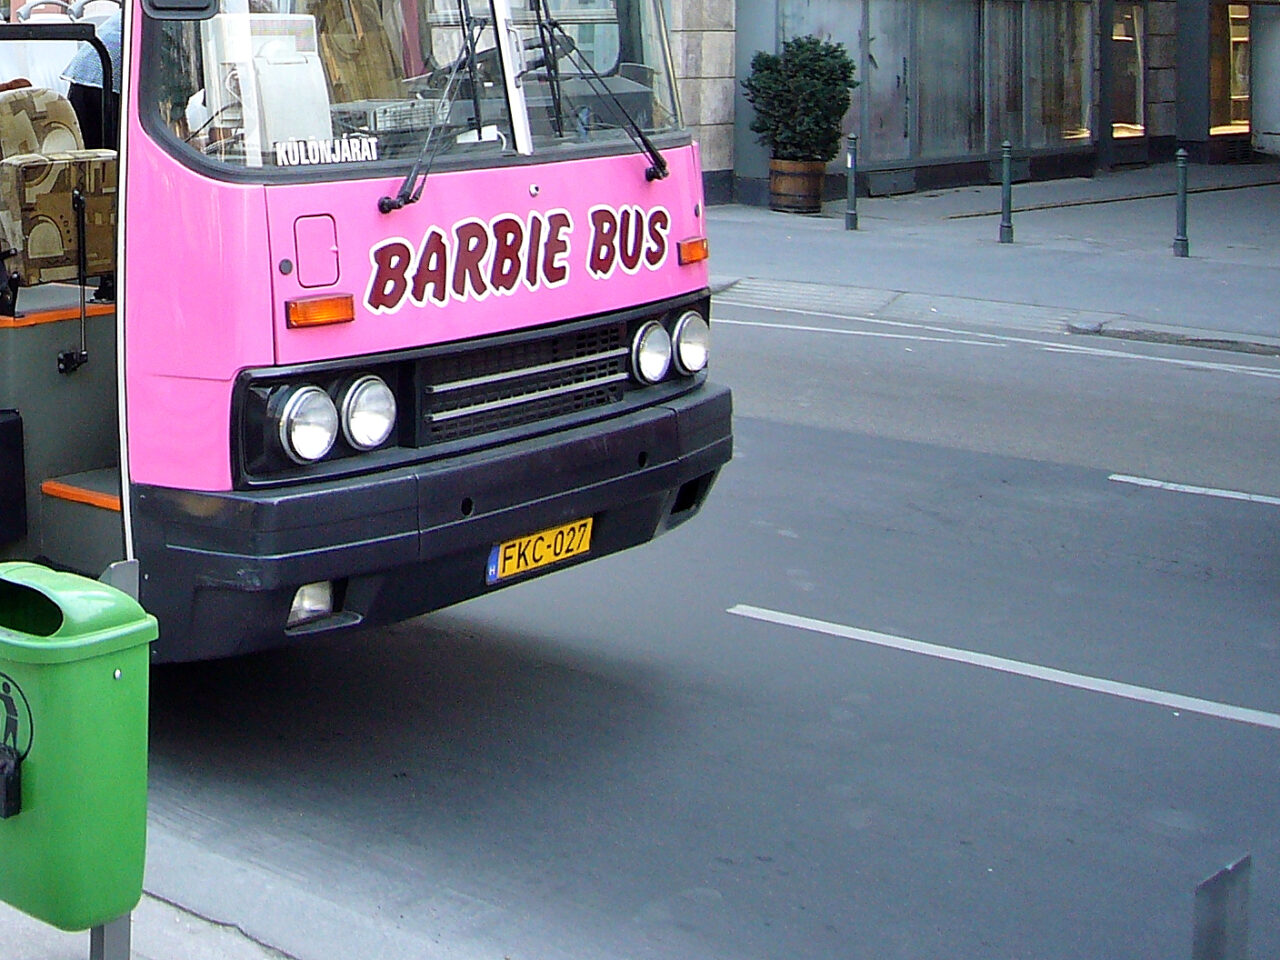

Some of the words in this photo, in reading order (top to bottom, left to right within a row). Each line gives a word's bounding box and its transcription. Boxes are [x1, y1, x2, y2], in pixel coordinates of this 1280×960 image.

[276, 132, 379, 167] KÜLÖNJÁRAT
[365, 209, 573, 313] BARBIE
[587, 205, 672, 280] BUS
[501, 522, 588, 574] FKC-027
